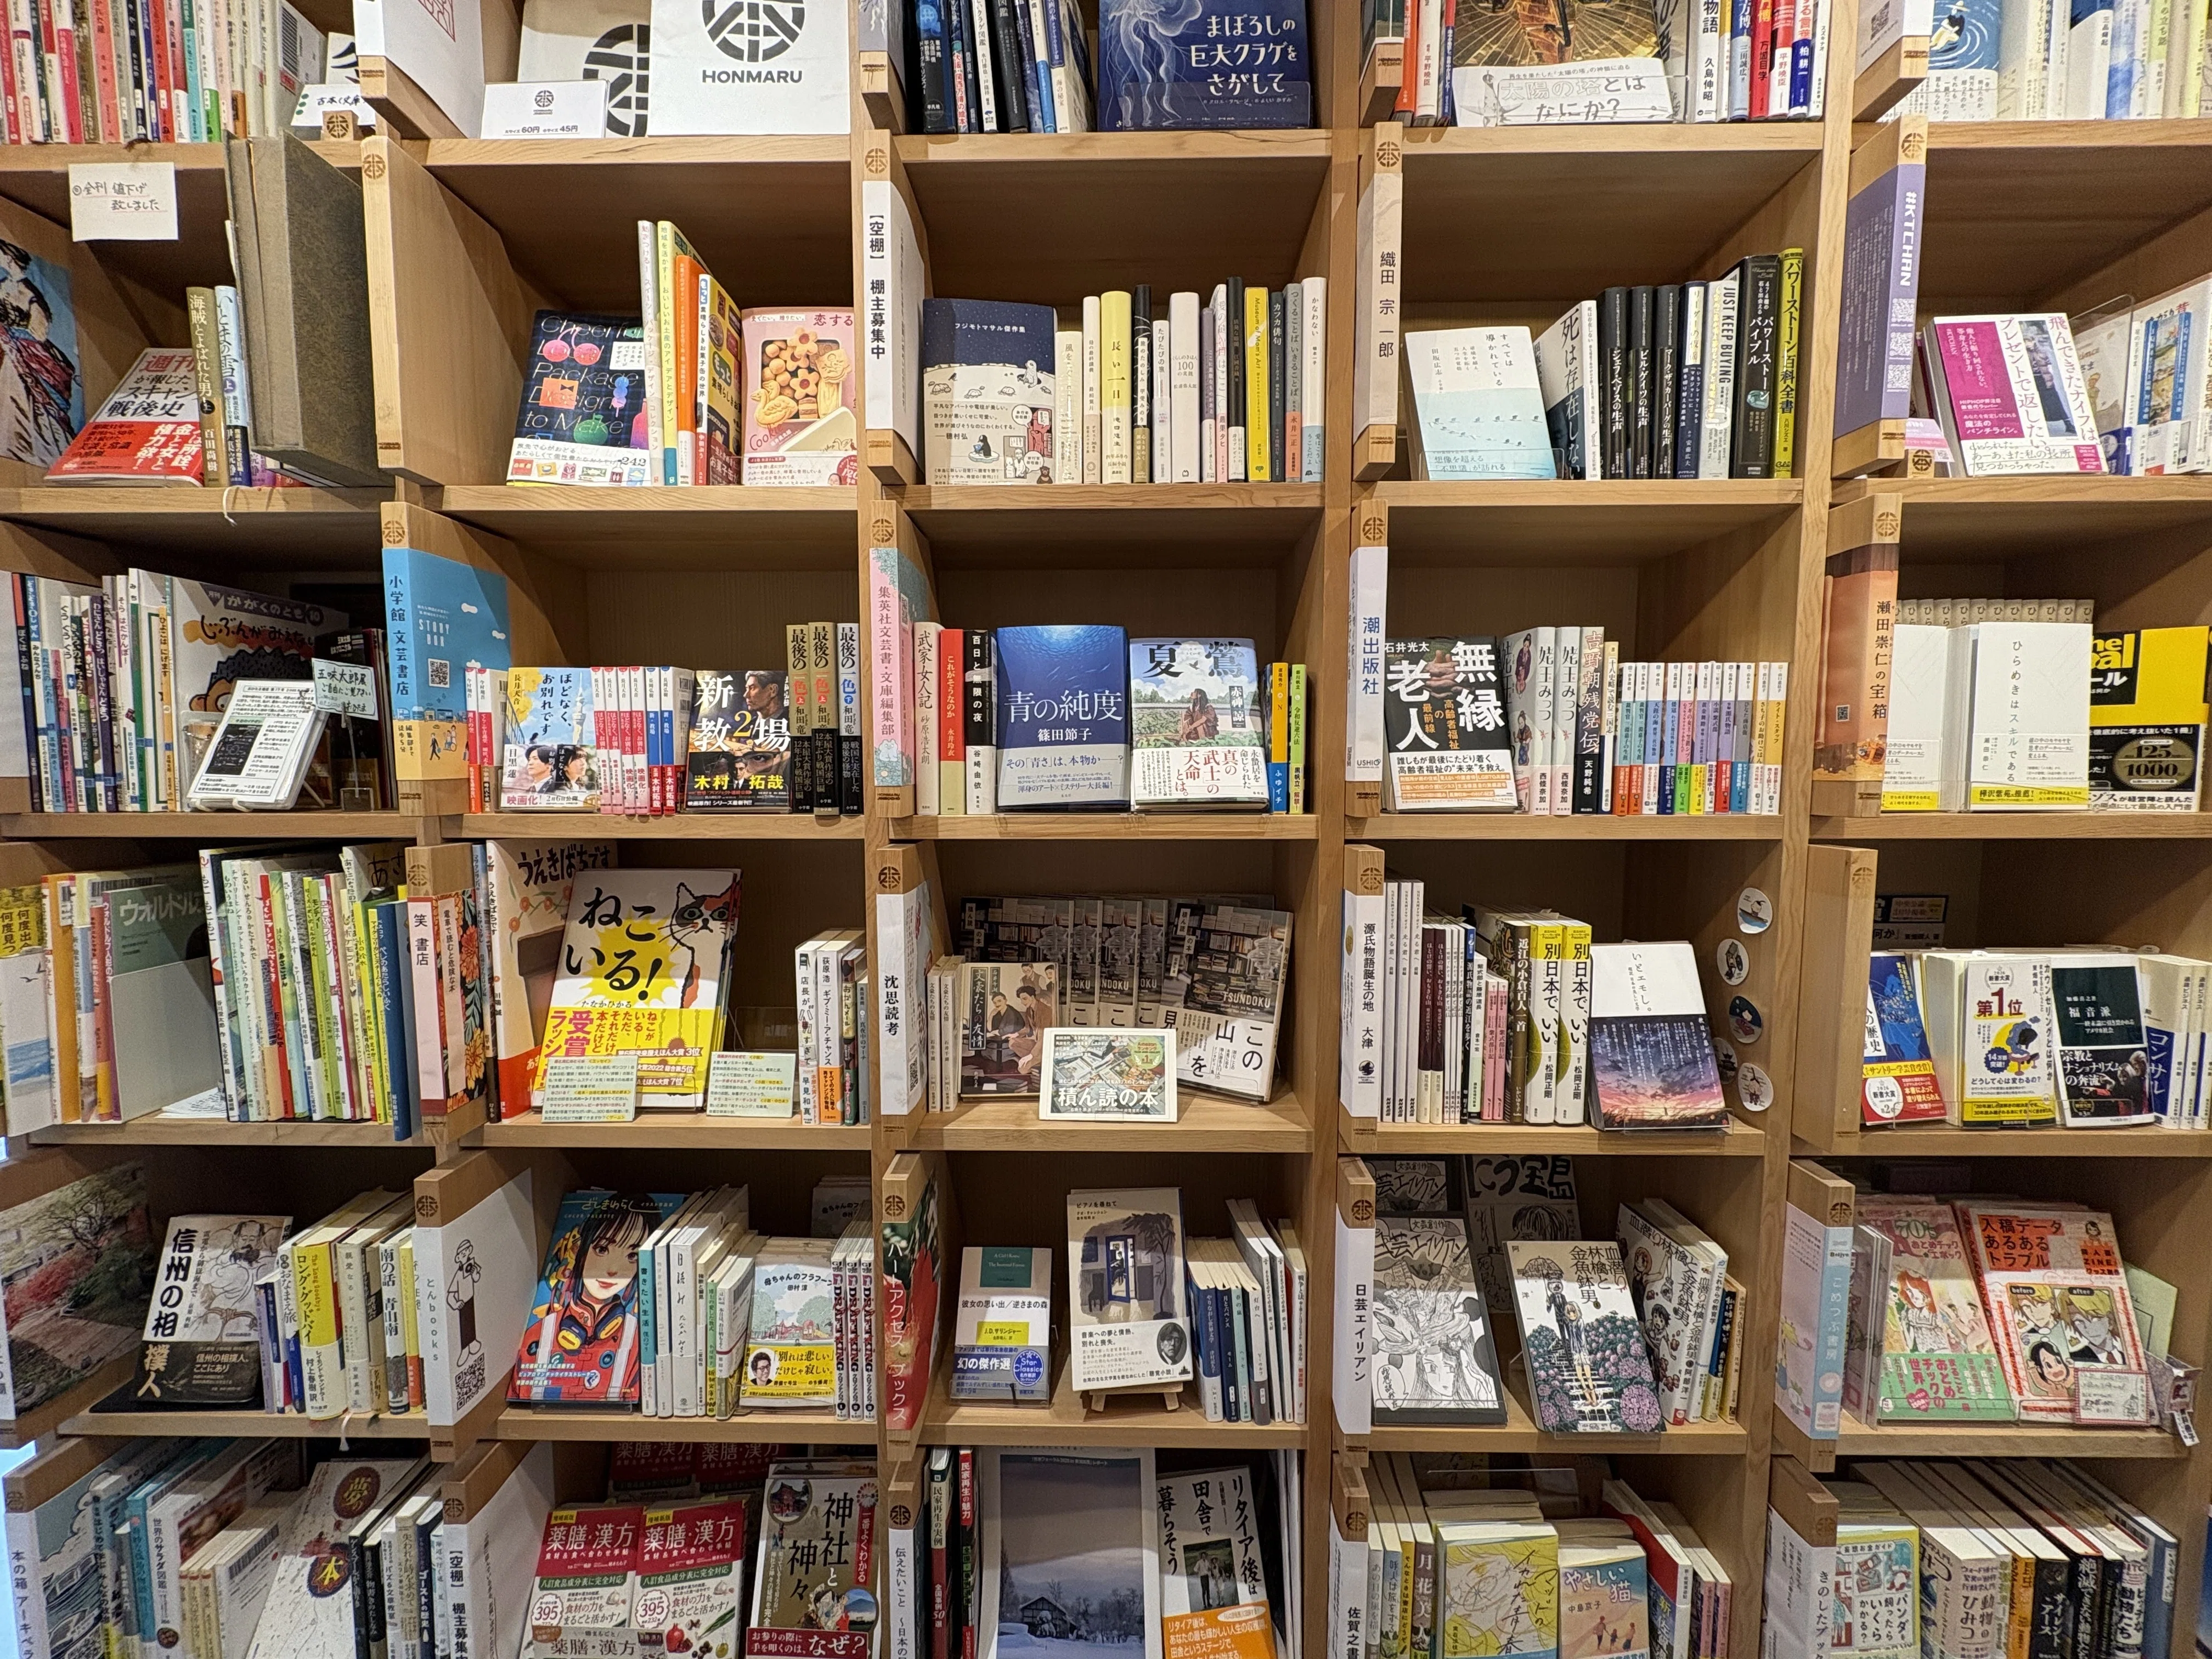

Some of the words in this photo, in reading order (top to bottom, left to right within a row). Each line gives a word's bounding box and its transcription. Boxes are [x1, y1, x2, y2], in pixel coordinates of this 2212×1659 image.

[1206, 15, 1296, 38] まぼろしの
[1190, 41, 1297, 67] 巨大クラゲを
[702, 70, 802, 83] HONMARU
[1208, 72, 1284, 95] さがして
[1500, 75, 1646, 101] 太陽の塔とは
[1703, 58, 1713, 101] 久島伸昭
[522, 126, 540, 134] 60円
[560, 125, 578, 134] 45円
[869, 215, 884, 259] 【空棚】
[1380, 251, 1396, 285] 織田
[813, 313, 853, 326] 恋する
[870, 279, 885, 359] 棚主募集中
[1291, 291, 1299, 343] つくることば
[1723, 287, 1736, 312] JUST
[955, 323, 1025, 333] フジモトマサル傑作集
[1273, 303, 1282, 346] カフカ俳句
[1722, 315, 1735, 340] KEEP
[1747, 318, 1762, 365] バイブル
[1779, 261, 1801, 415] パワーストーン百科全書
[1107, 340, 1126, 400] 長い一日
[1177, 362, 1194, 370] 100
[1718, 343, 1734, 383] BUYING
[1760, 317, 1774, 400] パワーストーン
[1611, 349, 1623, 433] ジェフ・ベゾスの生声
[1638, 349, 1649, 429] ビル・ゲイツの生声
[2000, 318, 2051, 452] プレゼントで返したい。
[105, 400, 185, 417] 戦後史
[526, 411, 549, 429] to
[389, 575, 407, 623] 小学館
[392, 630, 410, 696] 文芸書店
[839, 626, 857, 695] 最後の一色
[877, 585, 895, 736] 集英社文芸書・文庫編集部
[1362, 617, 1380, 695] 潮出版社
[1384, 641, 1430, 653] 石井光太
[1869, 600, 1892, 720] 瀬田崇仁の宝箱
[317, 668, 366, 687] 五味太郎展
[917, 630, 934, 709] 武家女人記
[946, 656, 956, 719] これがそうなのか
[972, 635, 983, 723] 百日と無限の夜
[1451, 640, 1505, 733] 無縁
[540, 674, 555, 736] お別れです
[560, 673, 572, 729] ほどなく、
[694, 675, 735, 709] 新
[1003, 690, 1124, 723] 青の純度
[1386, 659, 1440, 752] 老人
[1580, 630, 1603, 753] 吉野朝残党伝
[2006, 640, 2023, 782] ひらめきはスキルである
[1036, 727, 1093, 742] 篠田節子
[973, 749, 982, 790] 谷崎由依
[1396, 753, 1492, 765] 誰しもが最後にたどり着く
[1583, 759, 1594, 795] 天野純希
[2126, 762, 2179, 777] 1000
[694, 774, 730, 791] 木村
[748, 774, 784, 790] 拓哉
[1274, 769, 1283, 804] ふゆイチ
[517, 847, 611, 888] うえきばちです
[414, 913, 428, 928] 笑
[578, 886, 657, 943] ねこ
[415, 938, 430, 966] 書店
[443, 909, 456, 994] 電車で読むと危険な本
[1363, 922, 1376, 1012] 源氏物語誕生の地
[580, 1000, 633, 1008] たなかひかる
[1222, 991, 1272, 1008] TSUNDOKU
[1516, 938, 1530, 1032] 近江の小倉百人一首
[1976, 987, 2024, 1018] 第1位
[884, 975, 900, 1036] 沈思読考
[563, 1010, 595, 1057] 受賞
[822, 989, 832, 1066] ギブ・ミー・ア・チャンス
[1361, 1026, 1374, 1049] 大津
[802, 1077, 811, 1116] 早見和真
[1057, 1087, 1159, 1107] 積ん読の本
[1543, 1064, 1554, 1099] 松岡正剛
[1980, 1217, 2063, 1234] 入稿データ
[1984, 1235, 2051, 1252] あるある
[1988, 1252, 2051, 1268] トラブル
[641, 1267, 650, 1327] 書きたい生活
[888, 1243, 906, 1348] ハートアクセス
[1353, 1284, 1369, 1381] 日芸エイリアン
[957, 1357, 1011, 1370] 幻の傑作選
[1013, 1363, 1043, 1373] Classics
[1020, 1357, 1038, 1366] Star
[890, 1364, 907, 1421] ブックス
[1193, 1481, 1213, 1536] 田舎で
[547, 1521, 637, 1551] 薬膳・漢方
[857, 1511, 871, 1584] 一番よくわかる
[1158, 1487, 1178, 1576] 暮らそう
[1232, 1478, 1263, 1596] リタイア後は
[449, 1549, 464, 1588] 【空棚】
[787, 1540, 817, 1599] 神々
[1564, 1567, 1627, 1592] やさしい
[1609, 1582, 1632, 1603] 猫
[535, 1605, 560, 1621] 395
[1869, 1599, 1883, 1643] いくら
[808, 1634, 867, 1656] なぜ?
